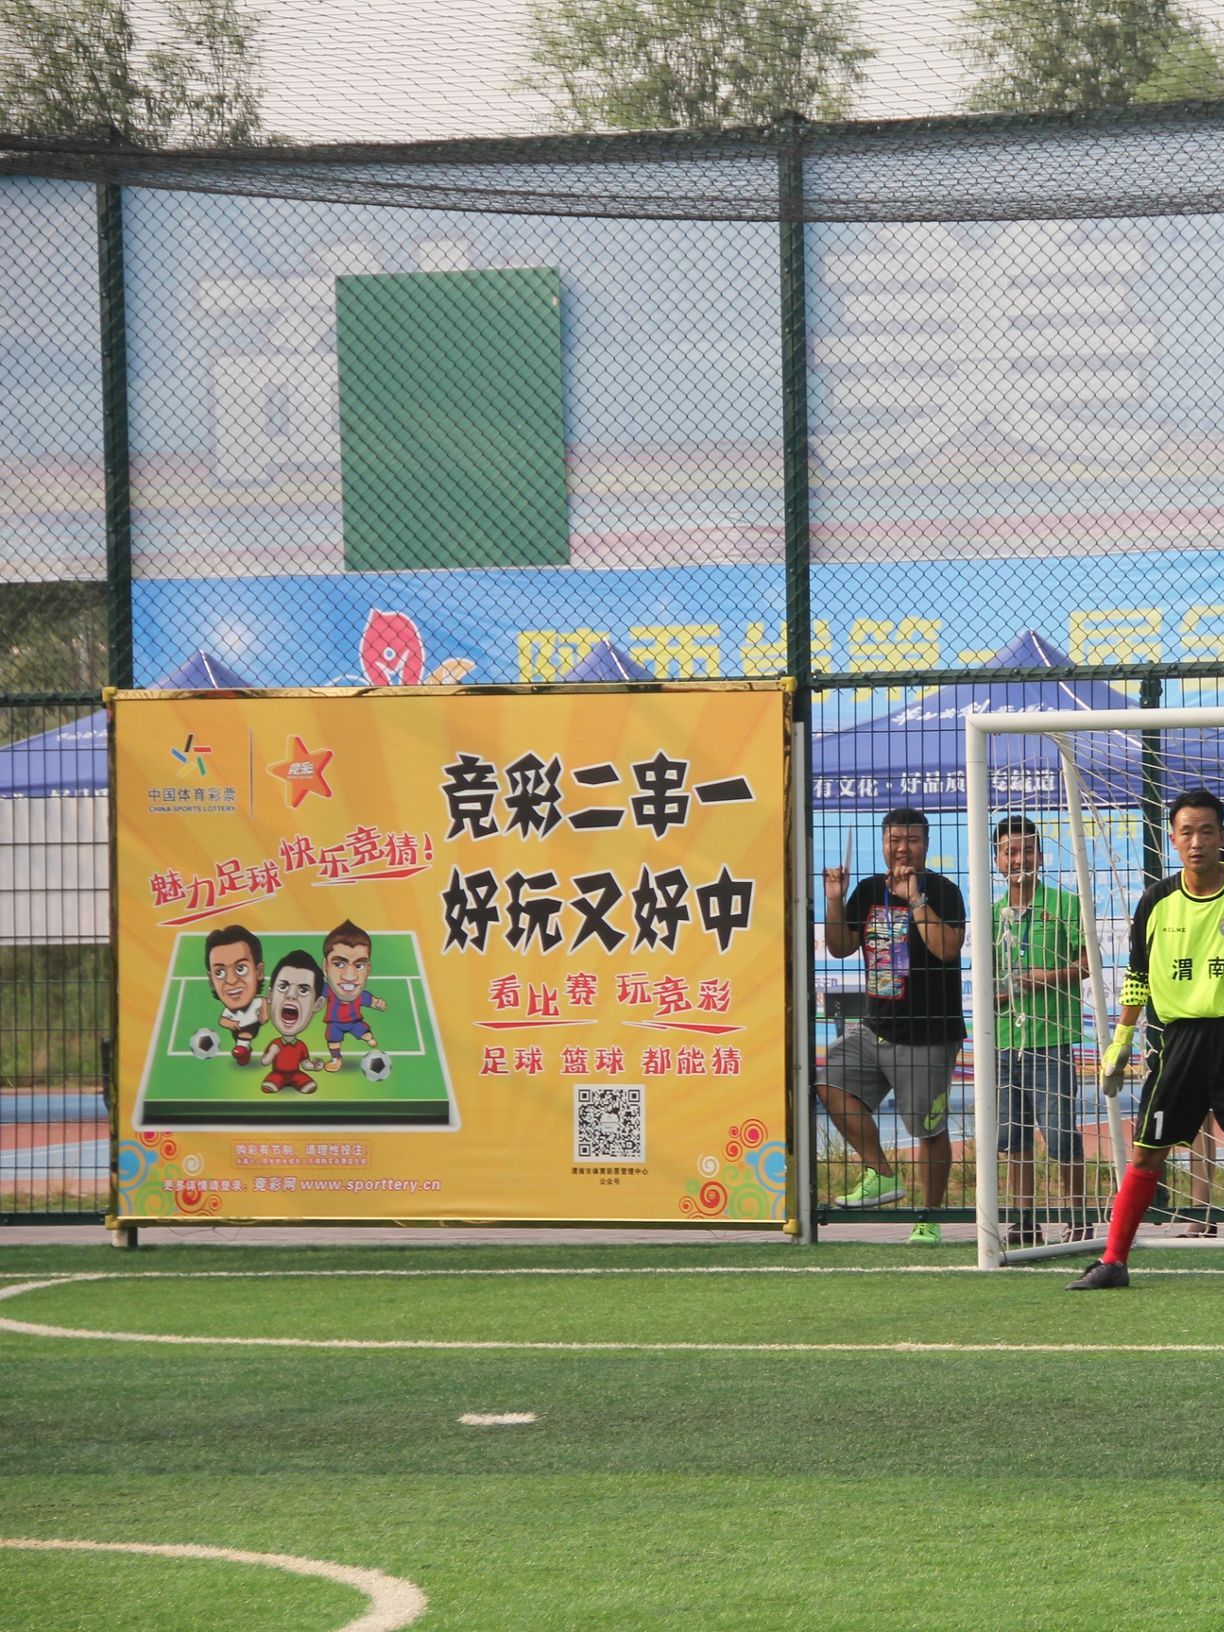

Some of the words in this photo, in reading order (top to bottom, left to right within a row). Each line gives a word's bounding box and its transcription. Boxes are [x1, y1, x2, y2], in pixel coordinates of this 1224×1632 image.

[148, 787, 236, 803] 中国体育彩票
[149, 805, 171, 813] CHINA
[439, 751, 754, 840] 竞彩二串一
[150, 858, 283, 909] 魅力足球
[440, 865, 754, 954] 好玩又好中
[490, 972, 597, 1016] 看比赛
[616, 973, 731, 1016] 玩竞彩
[480, 1046, 543, 1075] 足球
[561, 1046, 624, 1075] 篮球
[642, 1046, 741, 1075] 都能猜
[1153, 1110, 1164, 1141] 1
[253, 1176, 297, 1192] 竞彩网
[300, 1178, 441, 1193] www.sporttery.cn
